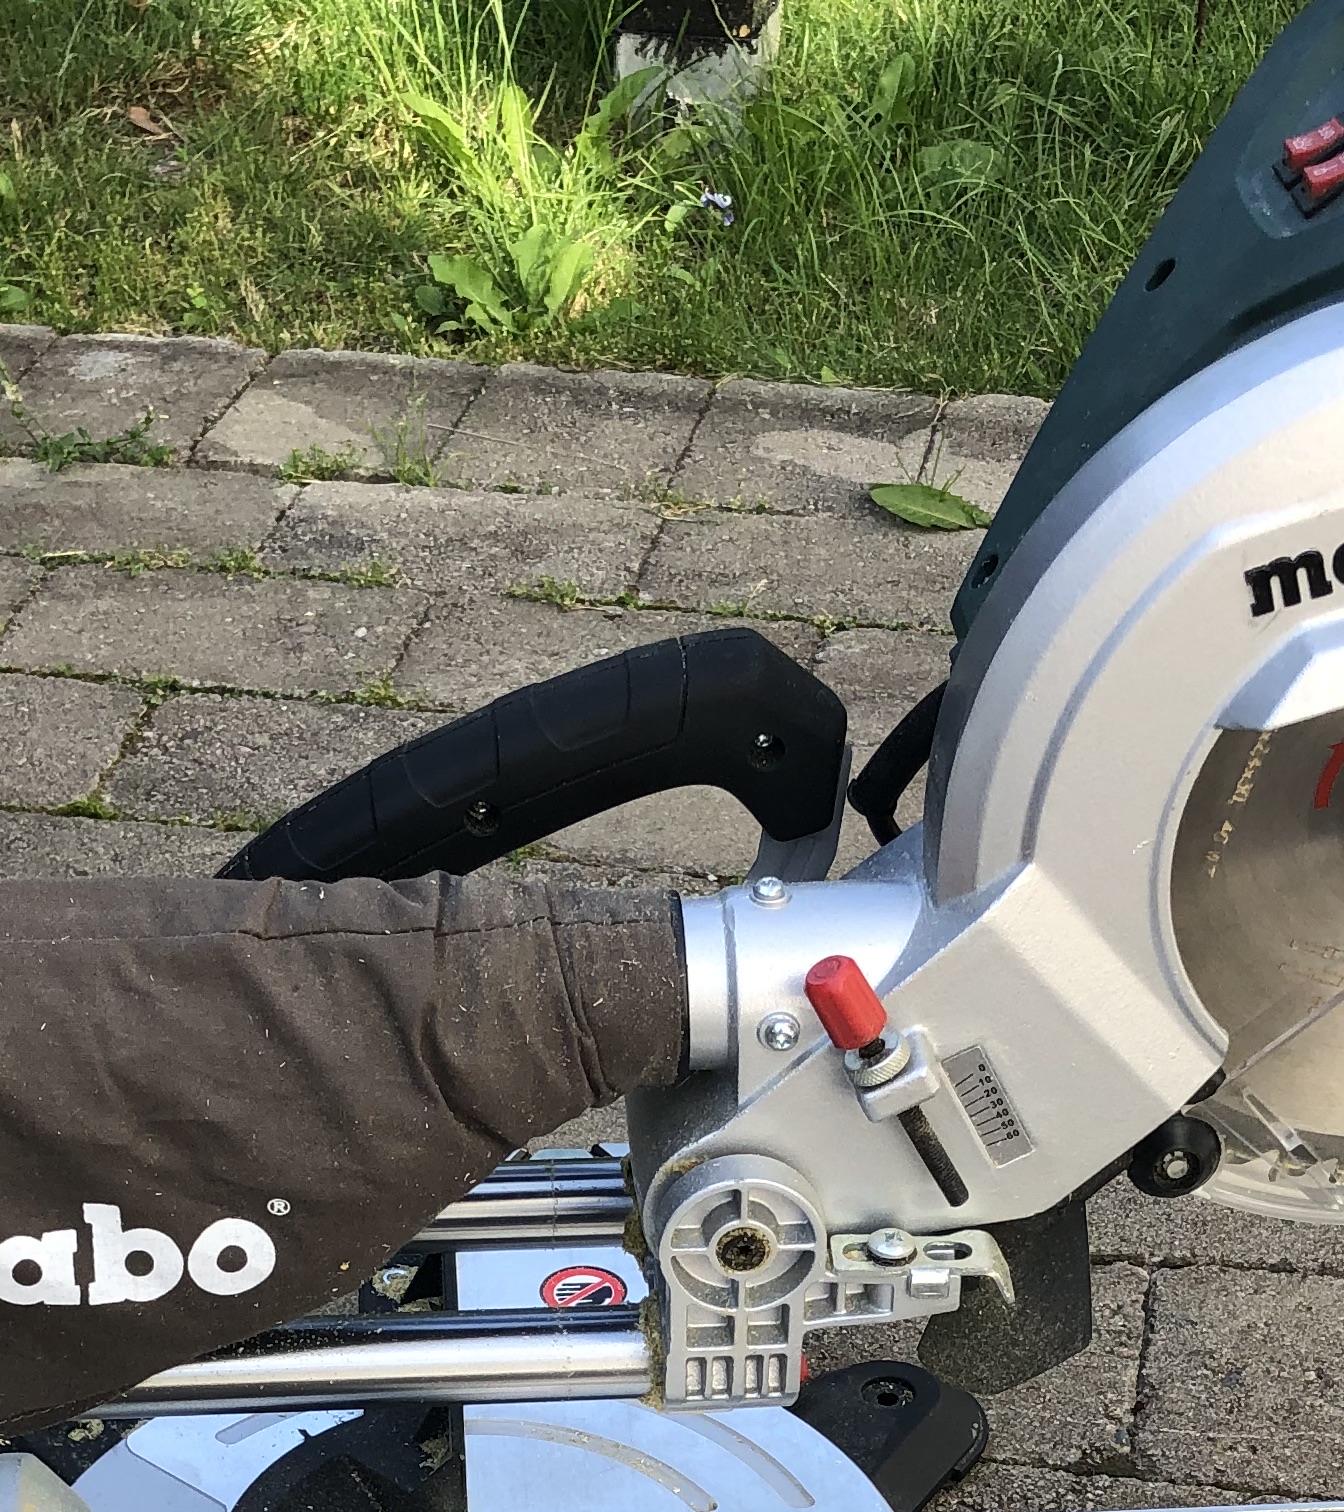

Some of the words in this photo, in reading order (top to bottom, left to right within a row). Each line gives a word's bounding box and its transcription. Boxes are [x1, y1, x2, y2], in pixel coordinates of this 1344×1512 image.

[977, 1063, 986, 1072] 0
[978, 1075, 993, 1087] 10
[983, 1086, 998, 1098] 20
[989, 1098, 1004, 1109] 30
[995, 1108, 1009, 1119] 40
[1000, 1119, 1015, 1130] 50
[1006, 1129, 1020, 1140] 60
